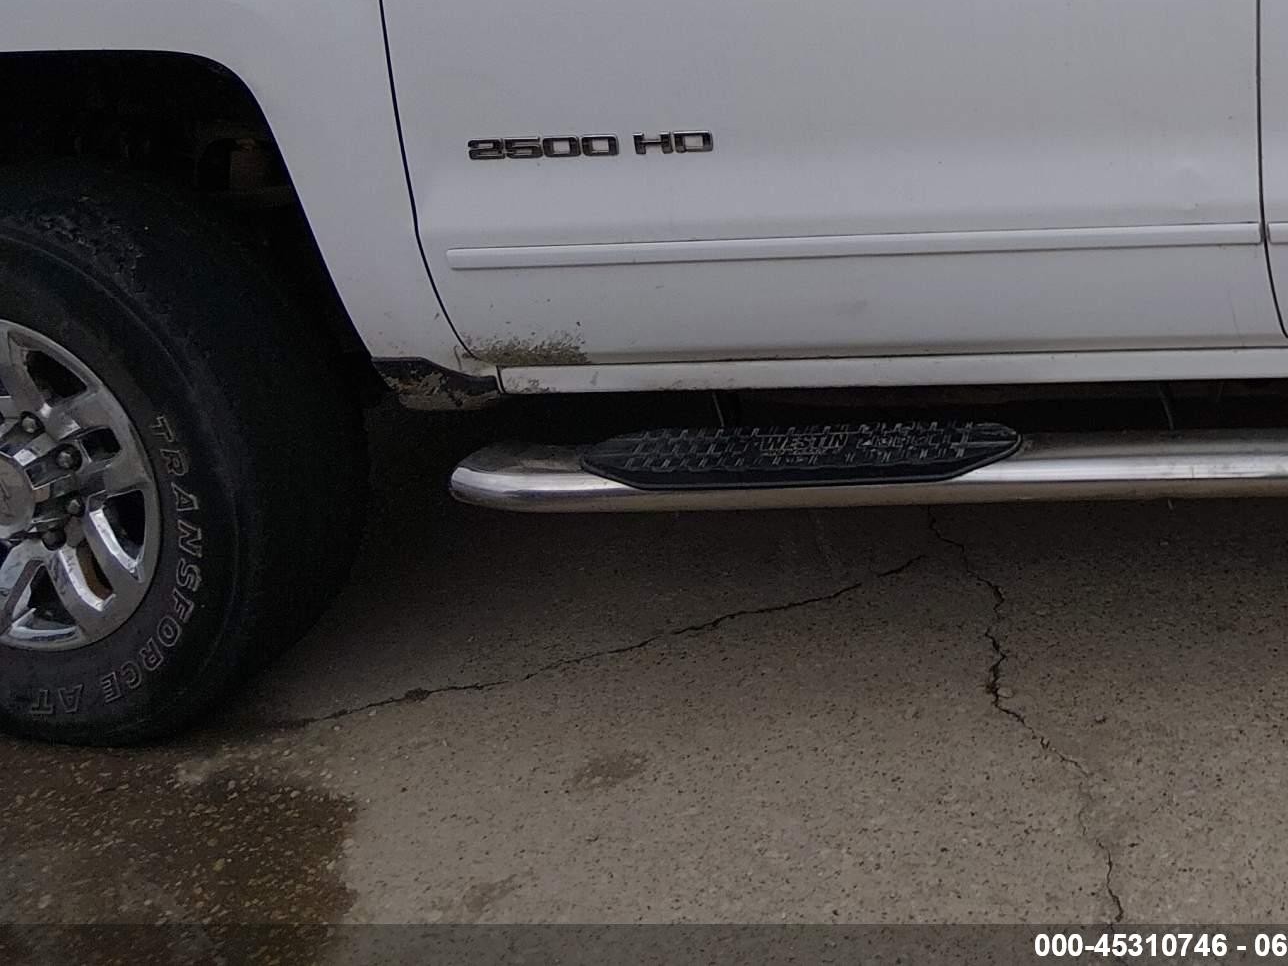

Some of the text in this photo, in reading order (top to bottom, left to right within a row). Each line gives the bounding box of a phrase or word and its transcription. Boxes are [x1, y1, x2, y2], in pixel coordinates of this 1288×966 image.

[467, 130, 714, 160] 2500 HD
[760, 434, 848, 452] WESTIN
[30, 416, 203, 715] TRANSFORCE AT
